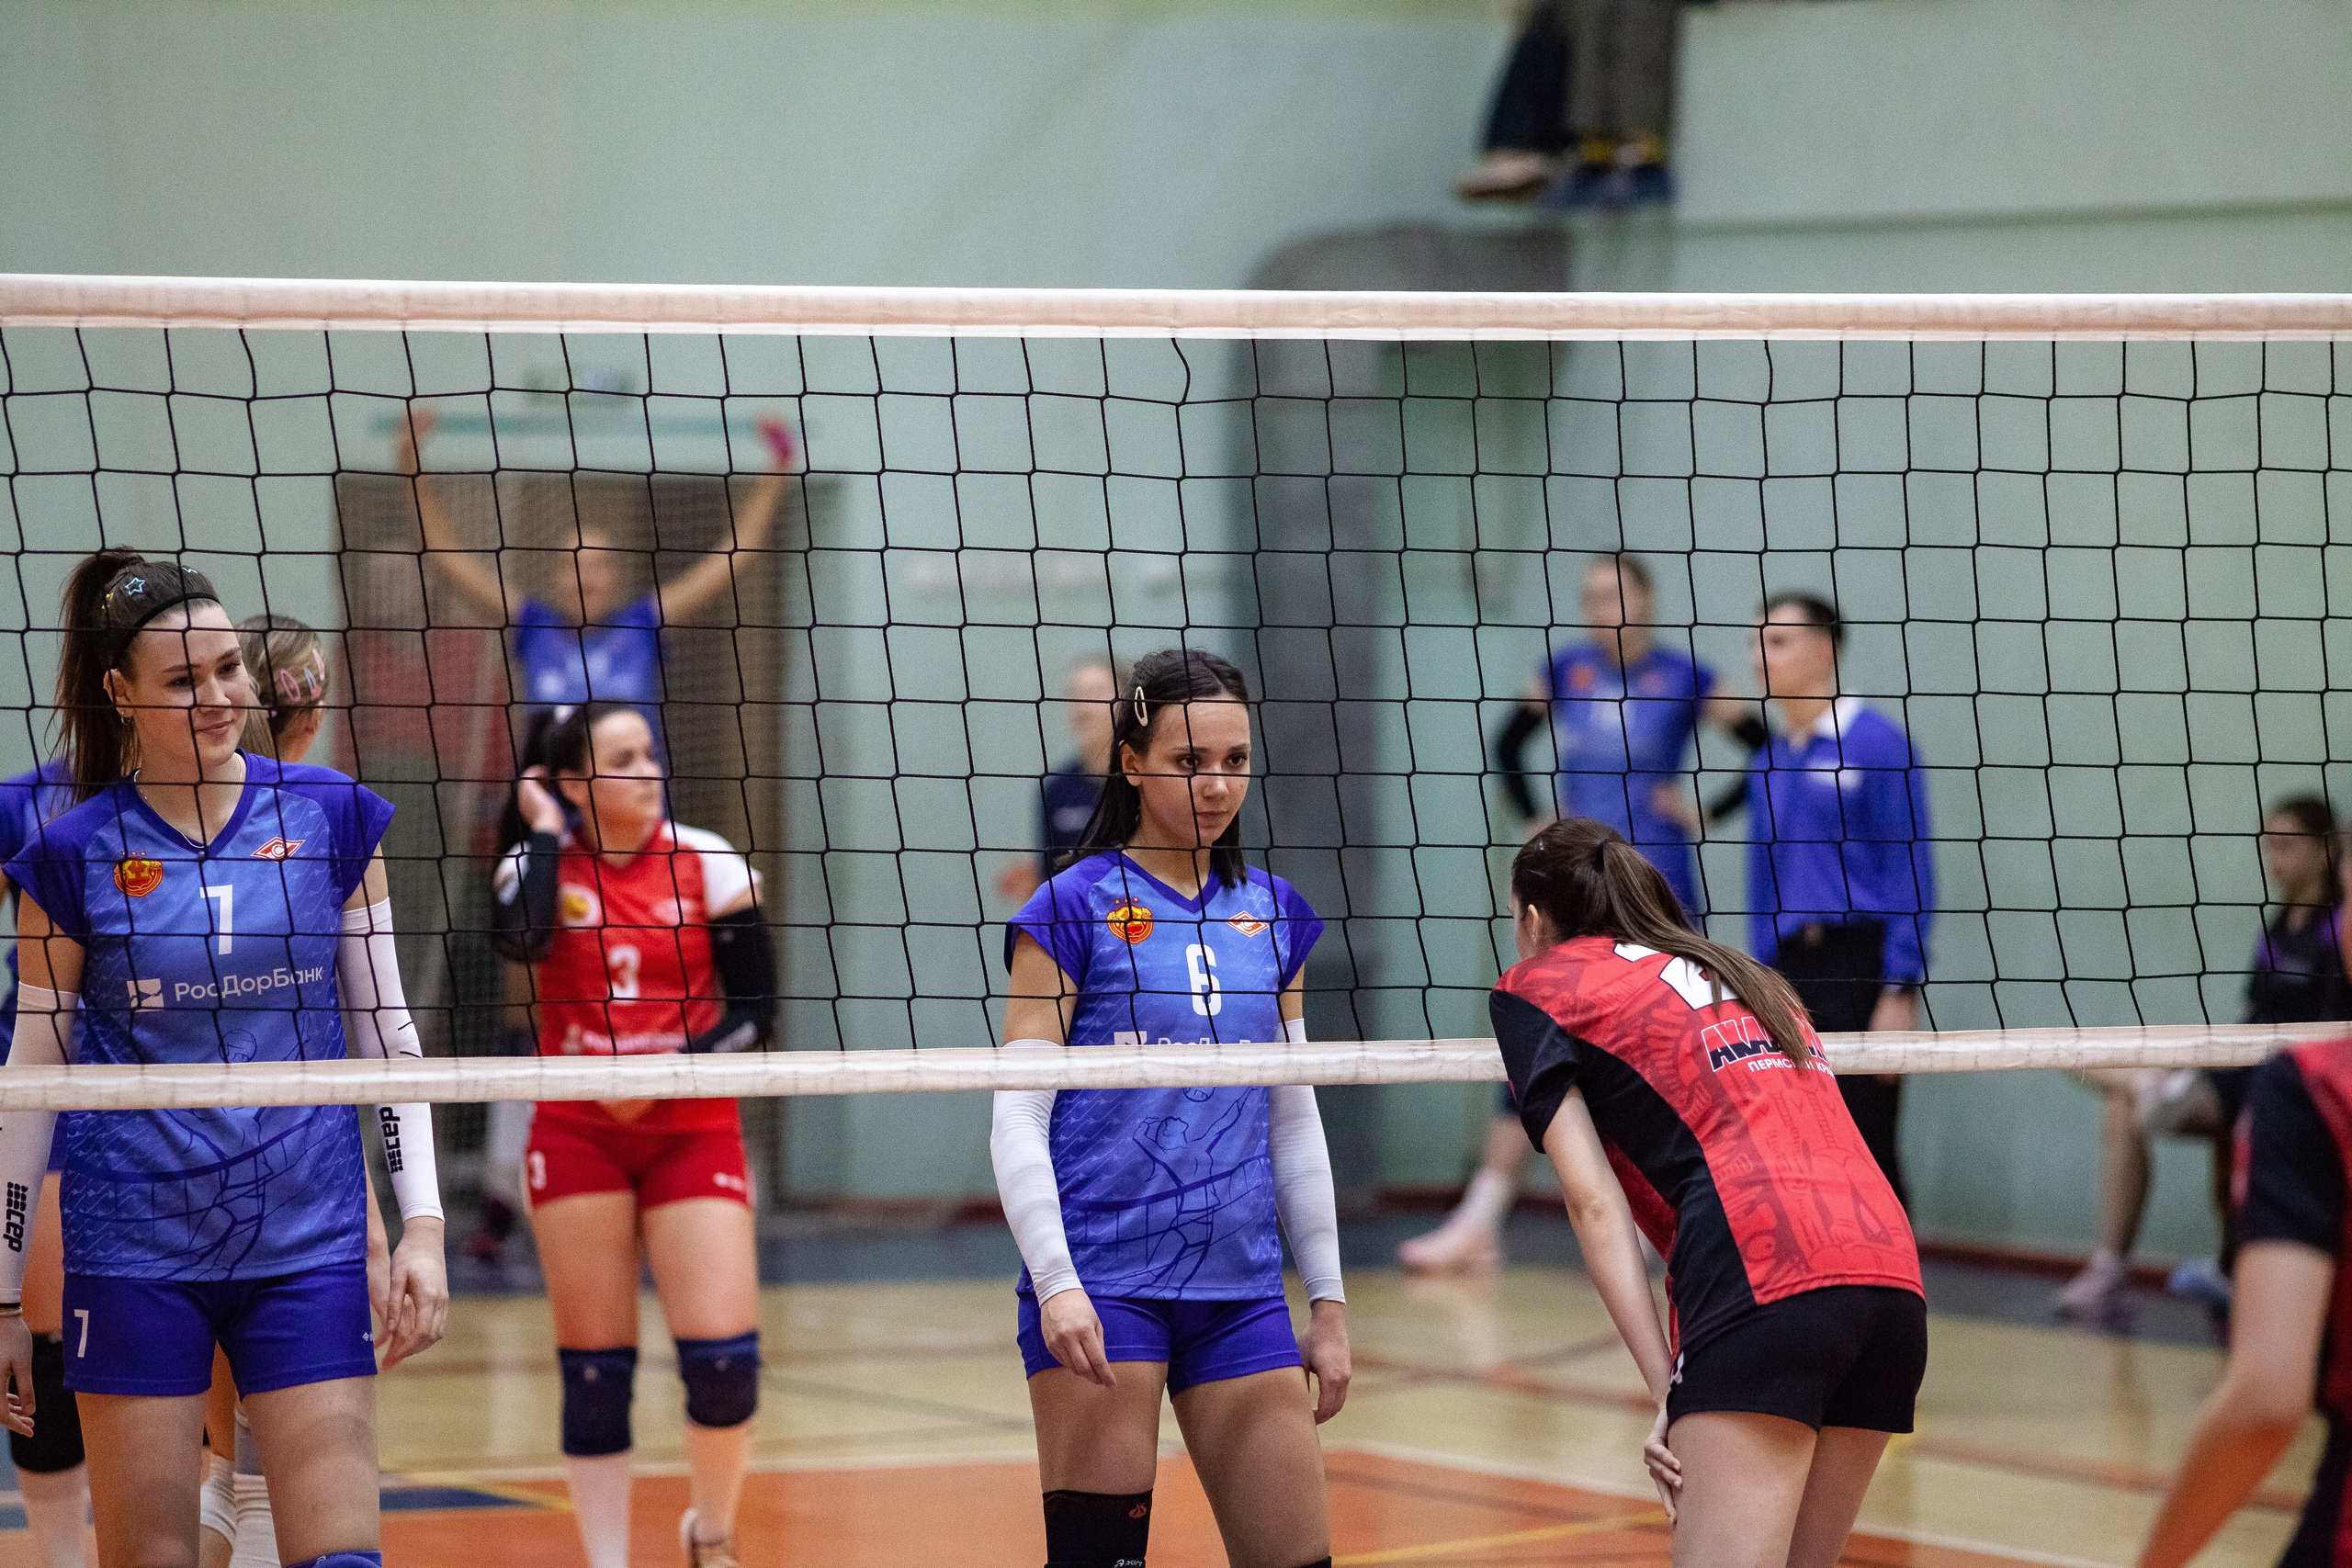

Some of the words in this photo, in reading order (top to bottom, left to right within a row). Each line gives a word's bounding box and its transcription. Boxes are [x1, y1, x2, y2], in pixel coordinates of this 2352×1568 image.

[199, 885, 233, 955] 7
[174, 966, 323, 1002] РосДорБанк
[607, 944, 640, 1006] 3
[1185, 943, 1222, 1016] 6
[378, 1106, 401, 1151] cep
[3, 1207, 26, 1253] cep
[74, 1308, 89, 1359] 7
